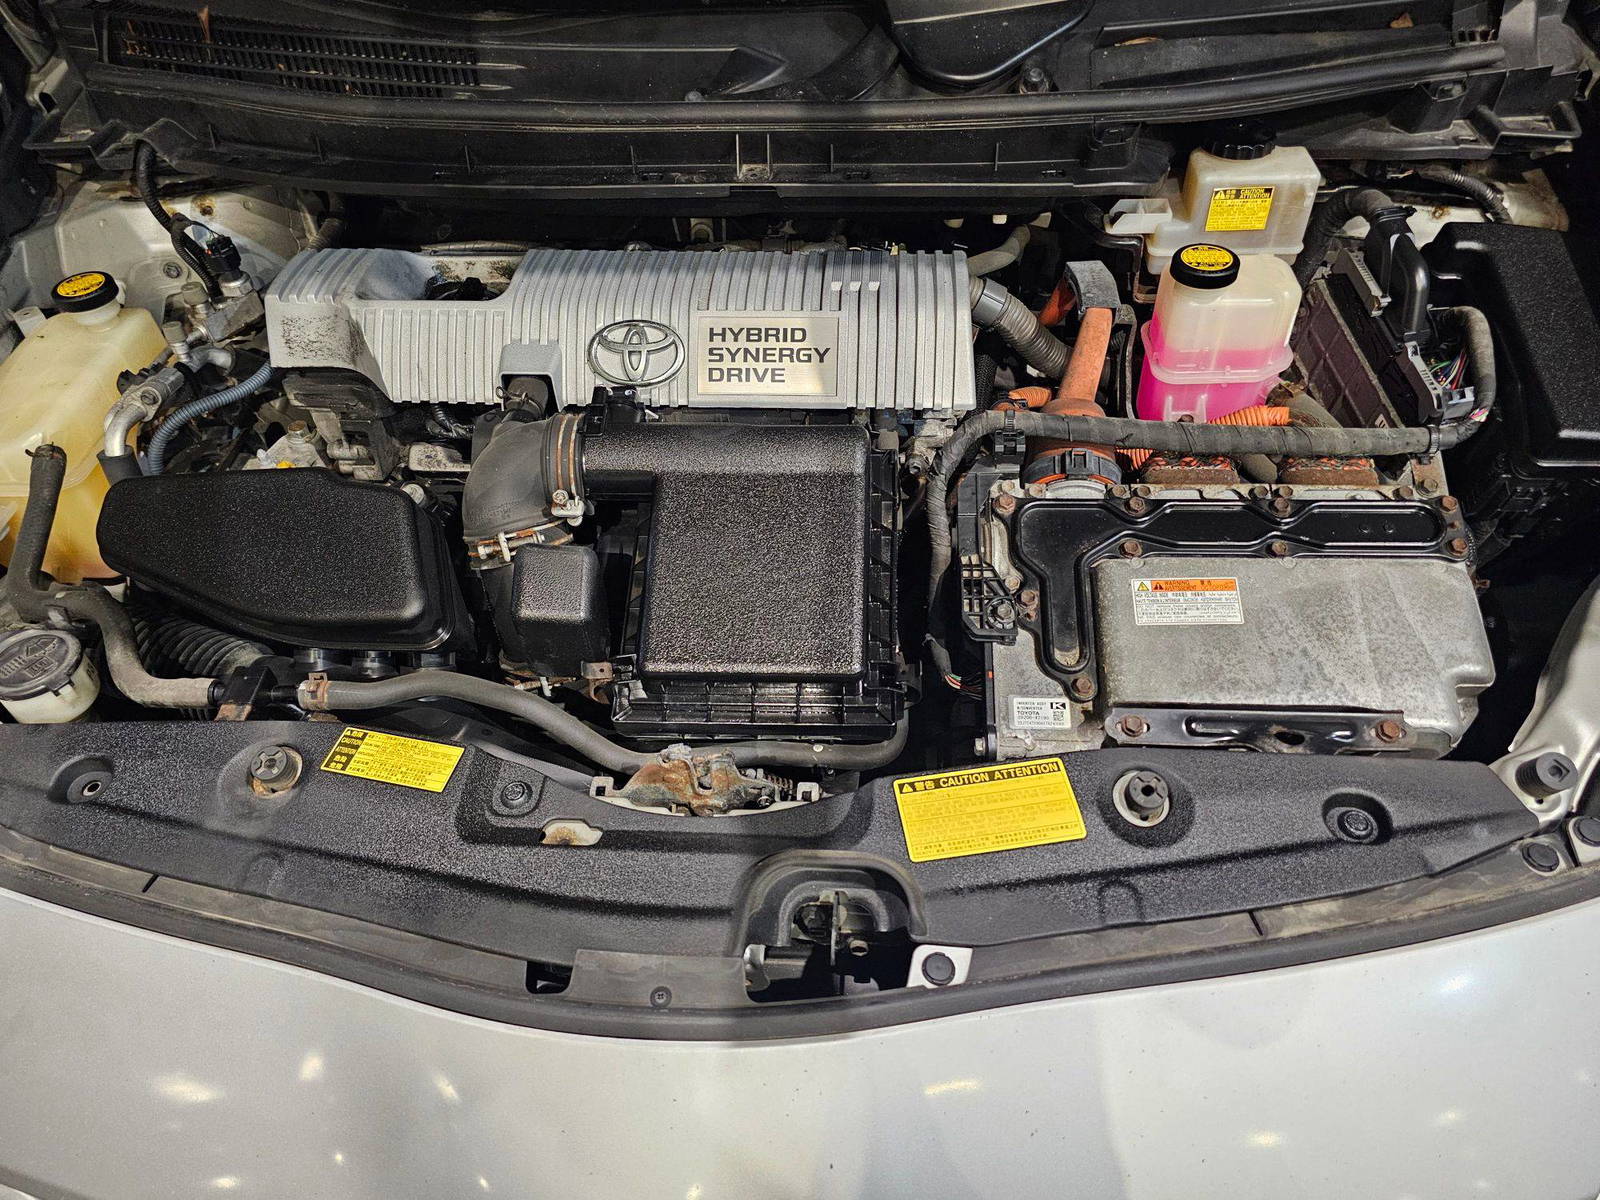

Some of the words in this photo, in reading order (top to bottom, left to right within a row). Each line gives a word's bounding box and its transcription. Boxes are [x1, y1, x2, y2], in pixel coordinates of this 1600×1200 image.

[708, 327, 807, 343] HYBRID
[708, 347, 831, 363] SYNERGY
[708, 367, 786, 383] DRIVE
[914, 780, 935, 791] 警告
[939, 772, 990, 788] CAUTION
[994, 762, 1059, 781] ATTENTION
